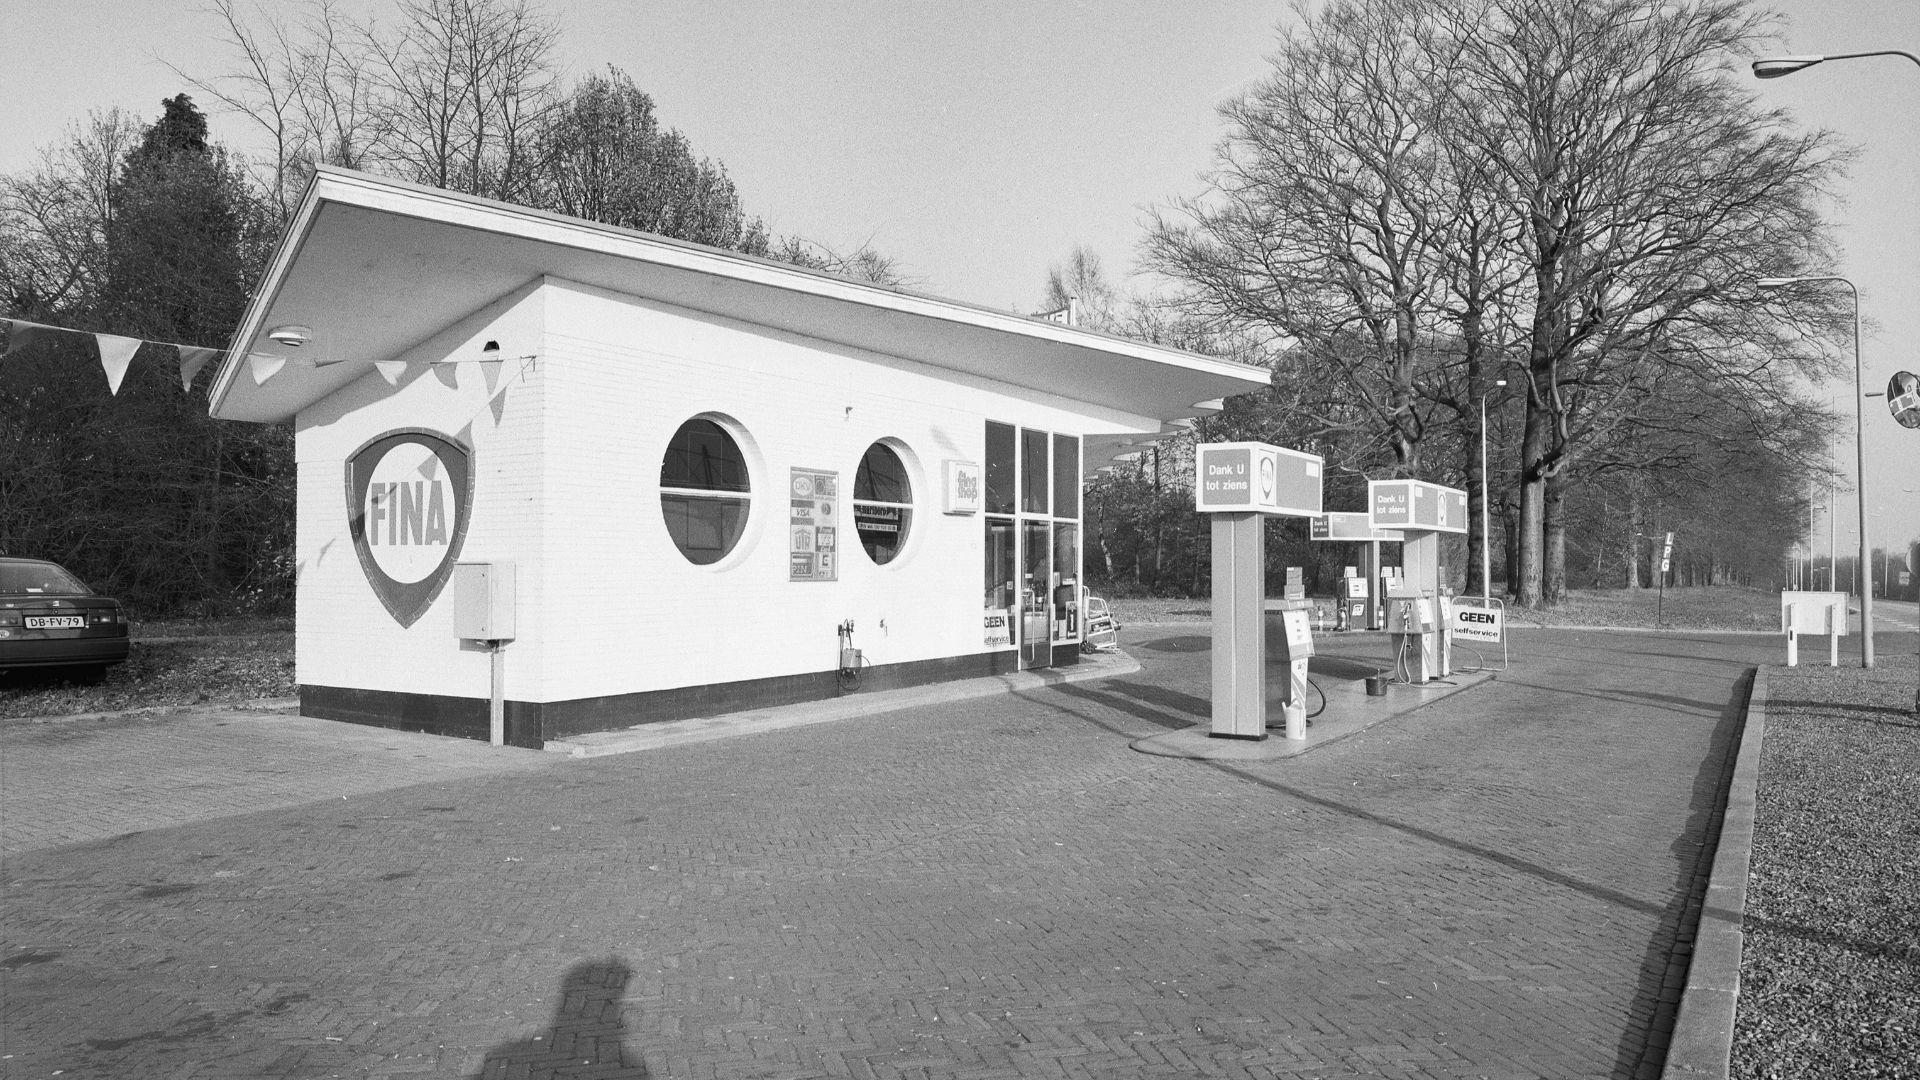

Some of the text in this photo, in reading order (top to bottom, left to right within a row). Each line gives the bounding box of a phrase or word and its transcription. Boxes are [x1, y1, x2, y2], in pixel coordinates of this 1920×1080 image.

[1208, 463, 1245, 475] Dank U
[1206, 479, 1248, 491] tot ziens
[1377, 495, 1405, 504] Dank U
[370, 480, 448, 546] FINA
[1376, 506, 1407, 514] tot ziens
[1660, 532, 1673, 571] LPG
[30, 617, 80, 627] DB-FV-79
[984, 615, 1005, 628] GEEN
[1459, 611, 1495, 624] GEEN
[1454, 627, 1498, 637] selfservice
